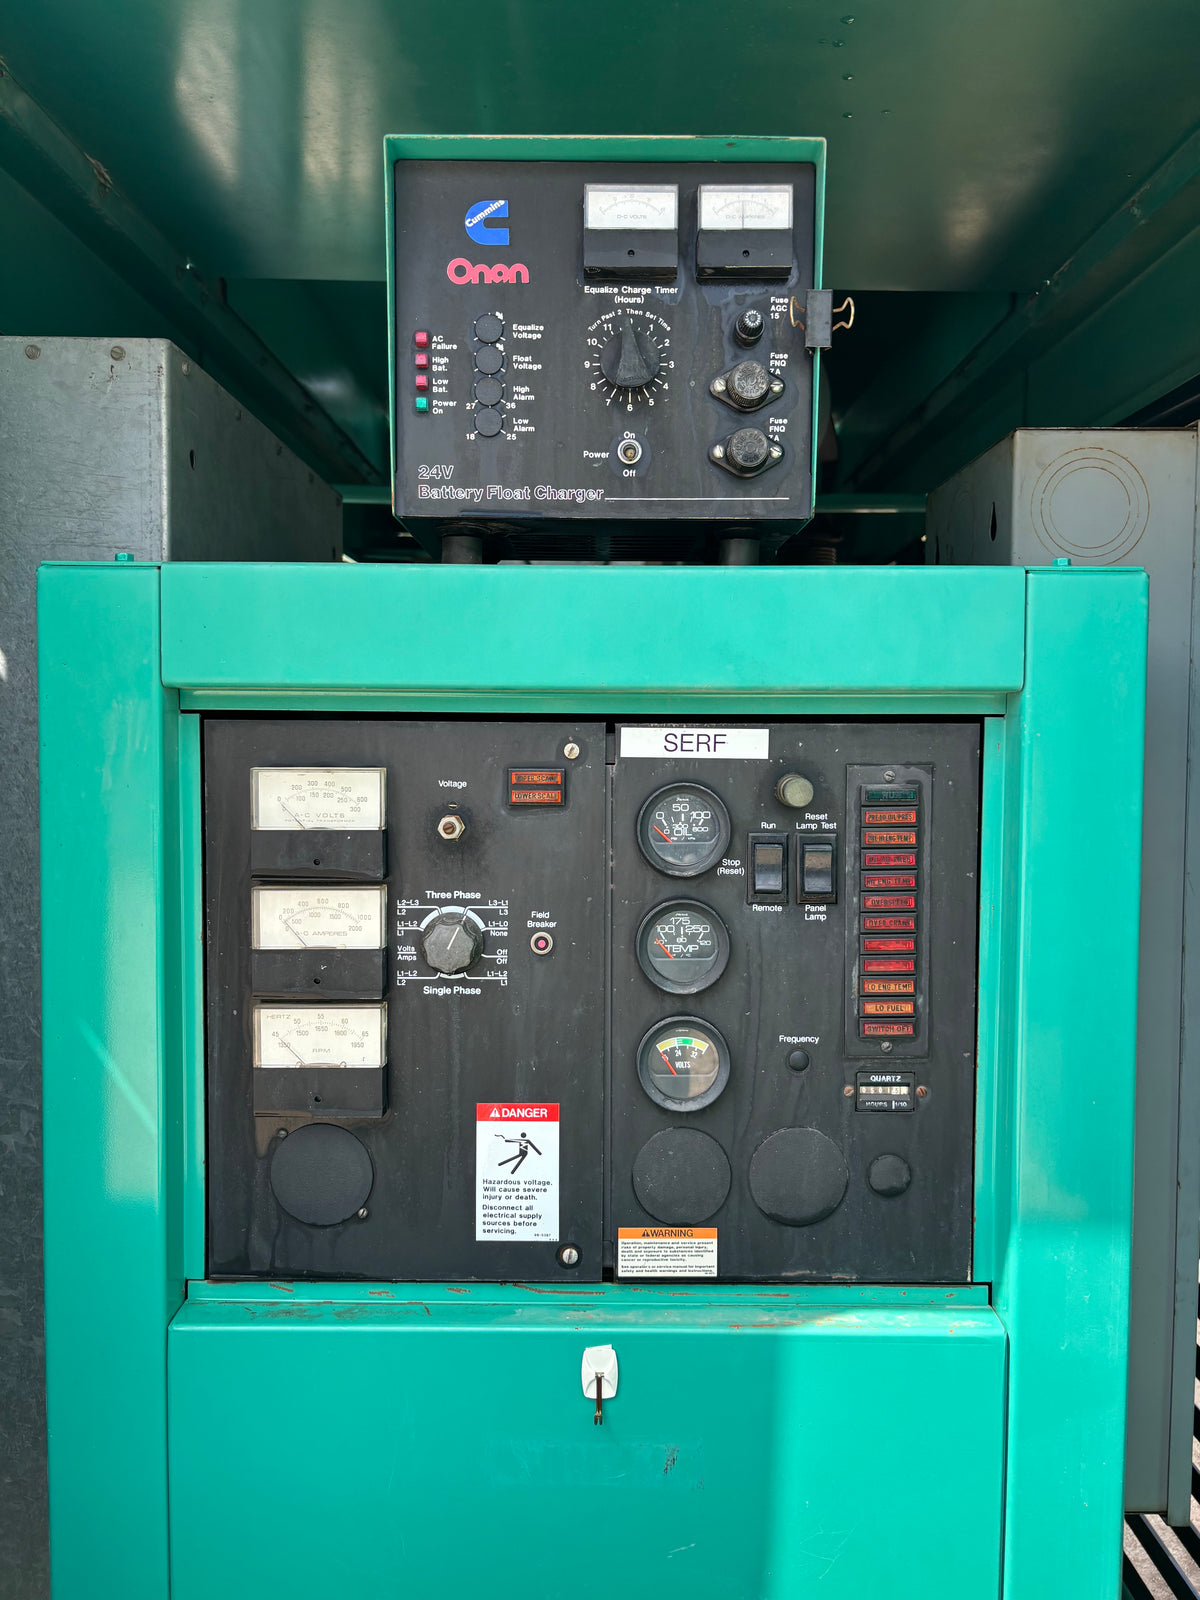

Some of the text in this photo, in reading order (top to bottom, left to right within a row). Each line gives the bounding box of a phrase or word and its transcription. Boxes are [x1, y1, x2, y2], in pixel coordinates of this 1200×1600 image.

[465, 199, 505, 227] Cummins
[447, 257, 529, 285] Onan
[584, 286, 678, 295] Equalize Charge Timer
[614, 295, 645, 304] (Hours)
[588, 319, 602, 332] Turn
[601, 310, 616, 321] Past
[626, 308, 643, 316] Then
[645, 312, 657, 321] Set
[657, 316, 671, 332] Time
[512, 324, 545, 332] Equalize
[603, 323, 612, 331] 11
[512, 332, 542, 340] Voltage
[587, 338, 670, 347] 10 2
[584, 361, 675, 369] 9 3
[513, 386, 530, 394] High
[590, 382, 669, 391] 8 4
[648, 398, 655, 406] 5
[627, 404, 633, 412] 6
[769, 425, 786, 433] FNQ
[623, 431, 636, 439] On
[583, 450, 610, 459] Power
[418, 465, 454, 479] 24V
[622, 469, 636, 478] Off
[418, 485, 604, 502] Battery Float Charger
[664, 733, 727, 753] SERF
[438, 780, 467, 789] Voltage
[690, 811, 711, 819] 100
[796, 822, 817, 830] Lamp
[674, 828, 692, 836] OIL
[722, 859, 740, 867] Stop
[717, 868, 745, 876] (Reset)
[425, 891, 481, 899] Three Phase
[670, 917, 690, 925] 175
[804, 913, 827, 922] Lamp
[423, 986, 481, 995] Single Phase
[867, 1025, 894, 1033] SWITCH
[779, 1034, 819, 1045] Frequency
[690, 1051, 698, 1059] 32
[675, 1061, 691, 1069] VOLTS
[502, 1108, 547, 1117] DANGER
[650, 1229, 693, 1237] WARNING
